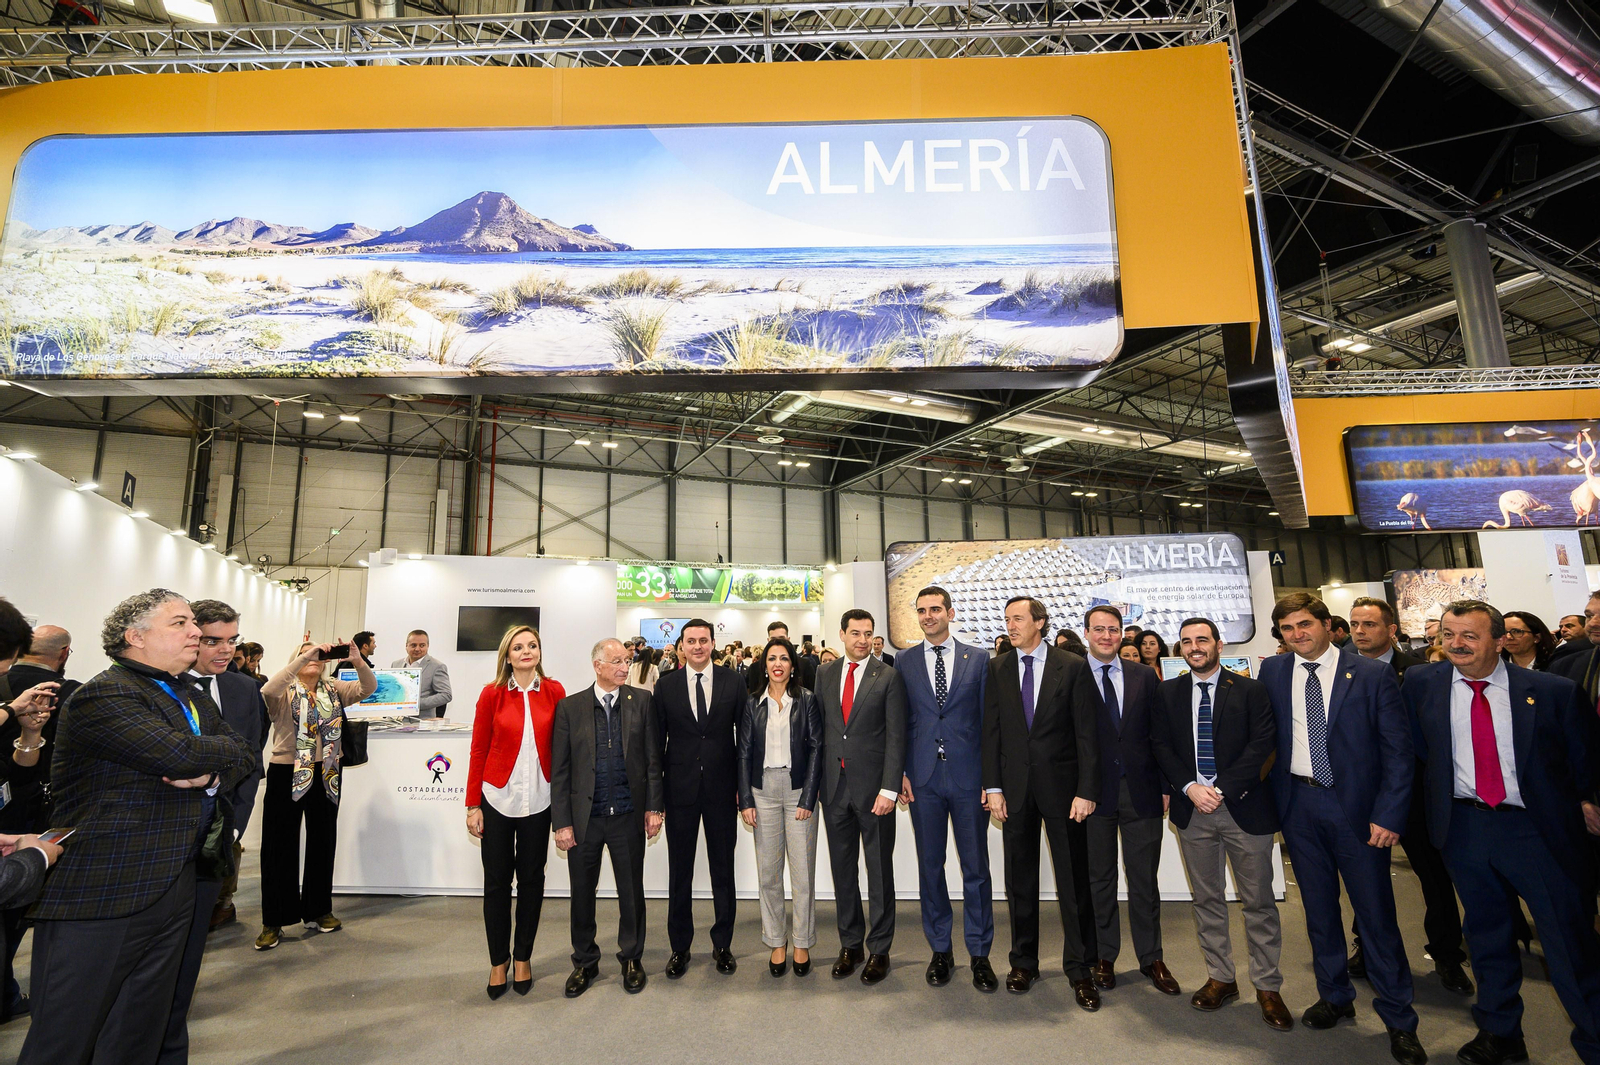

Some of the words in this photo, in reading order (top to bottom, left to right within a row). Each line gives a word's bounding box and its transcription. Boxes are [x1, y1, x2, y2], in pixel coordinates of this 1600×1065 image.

[766, 126, 1086, 195] ALMERÍA
[16, 352, 41, 363] Playa
[44, 352, 55, 361] de
[57, 352, 74, 361] Los
[124, 479, 132, 502] A
[1104, 537, 1239, 570] ALMERÍA
[1273, 553, 1284, 564] A
[635, 572, 667, 598] 33
[1126, 585, 1134, 593] El
[1136, 586, 1158, 594] mayor
[1160, 585, 1184, 593] centro
[1196, 583, 1244, 592] investigación
[1157, 592, 1185, 602] energía
[1207, 591, 1216, 599] de
